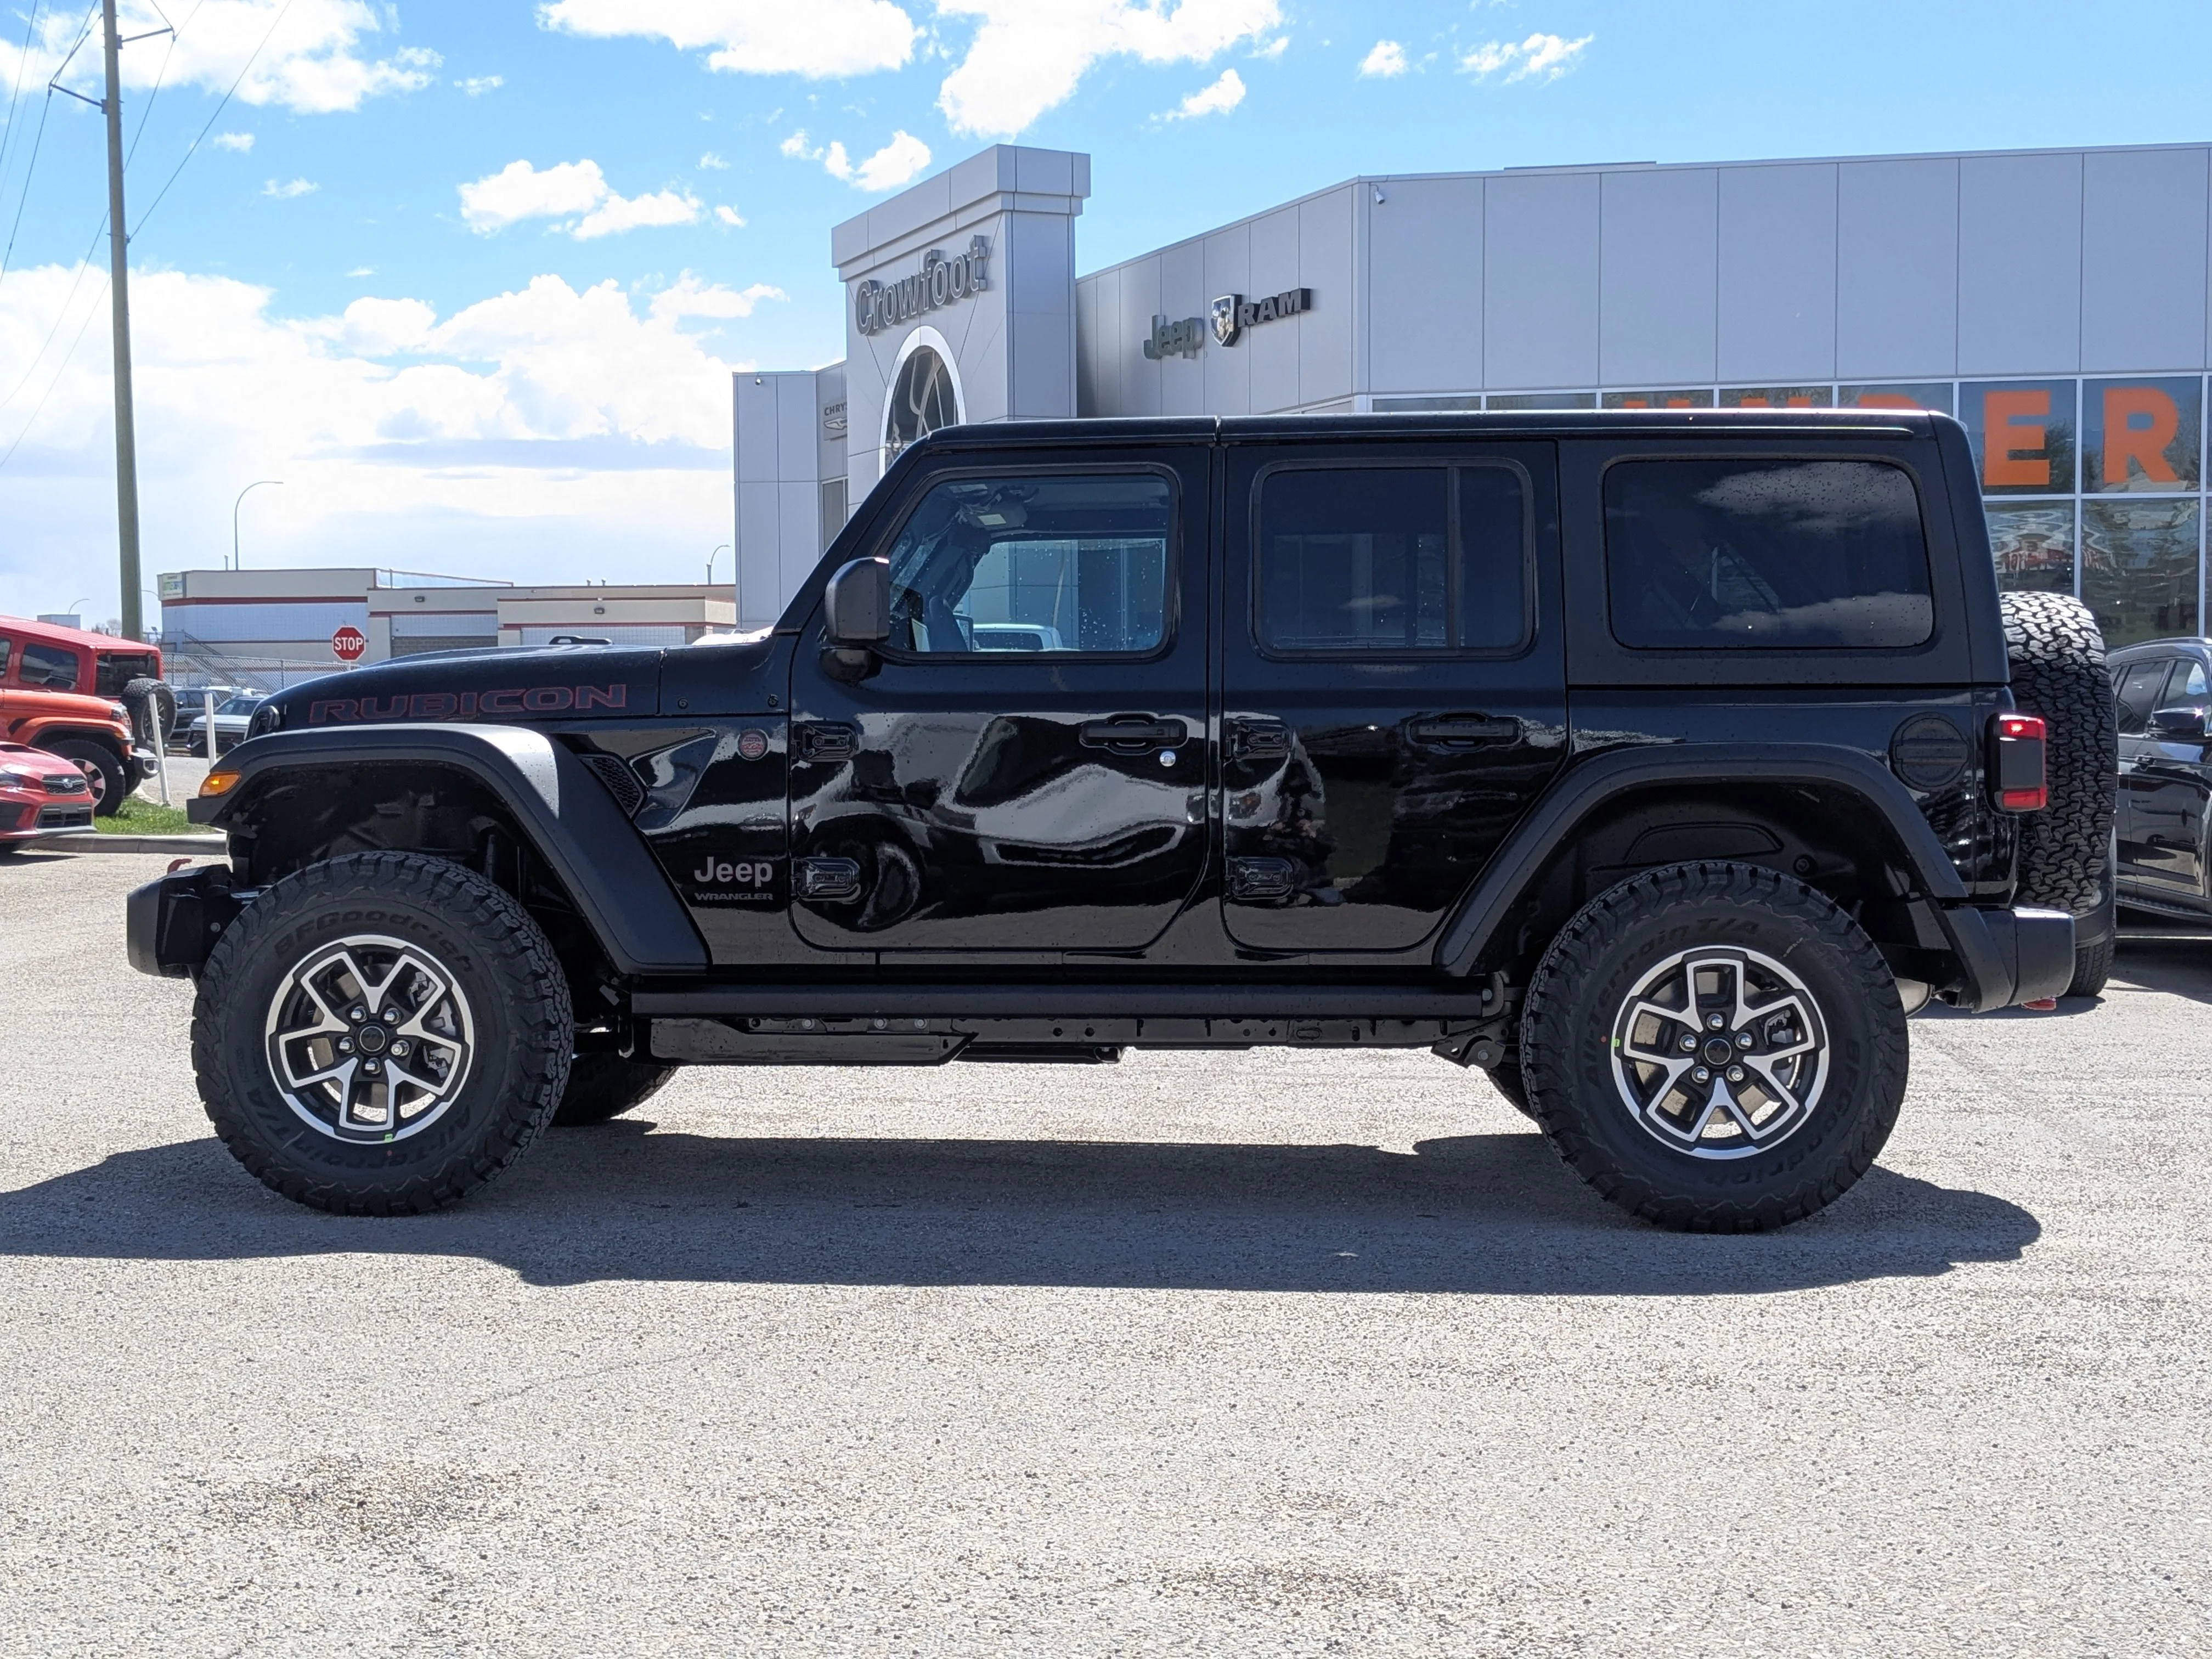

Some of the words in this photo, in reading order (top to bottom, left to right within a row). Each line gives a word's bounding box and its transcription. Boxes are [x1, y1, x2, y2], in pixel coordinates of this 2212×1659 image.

[855, 235, 987, 336] Crowfoot
[1238, 288, 1311, 326] RAM
[1143, 315, 1204, 359] Jeep
[334, 637, 363, 651] STOP
[309, 684, 627, 723] RUBICON
[694, 856, 772, 887] Jeep
[275, 910, 473, 972] BFGoodrich
